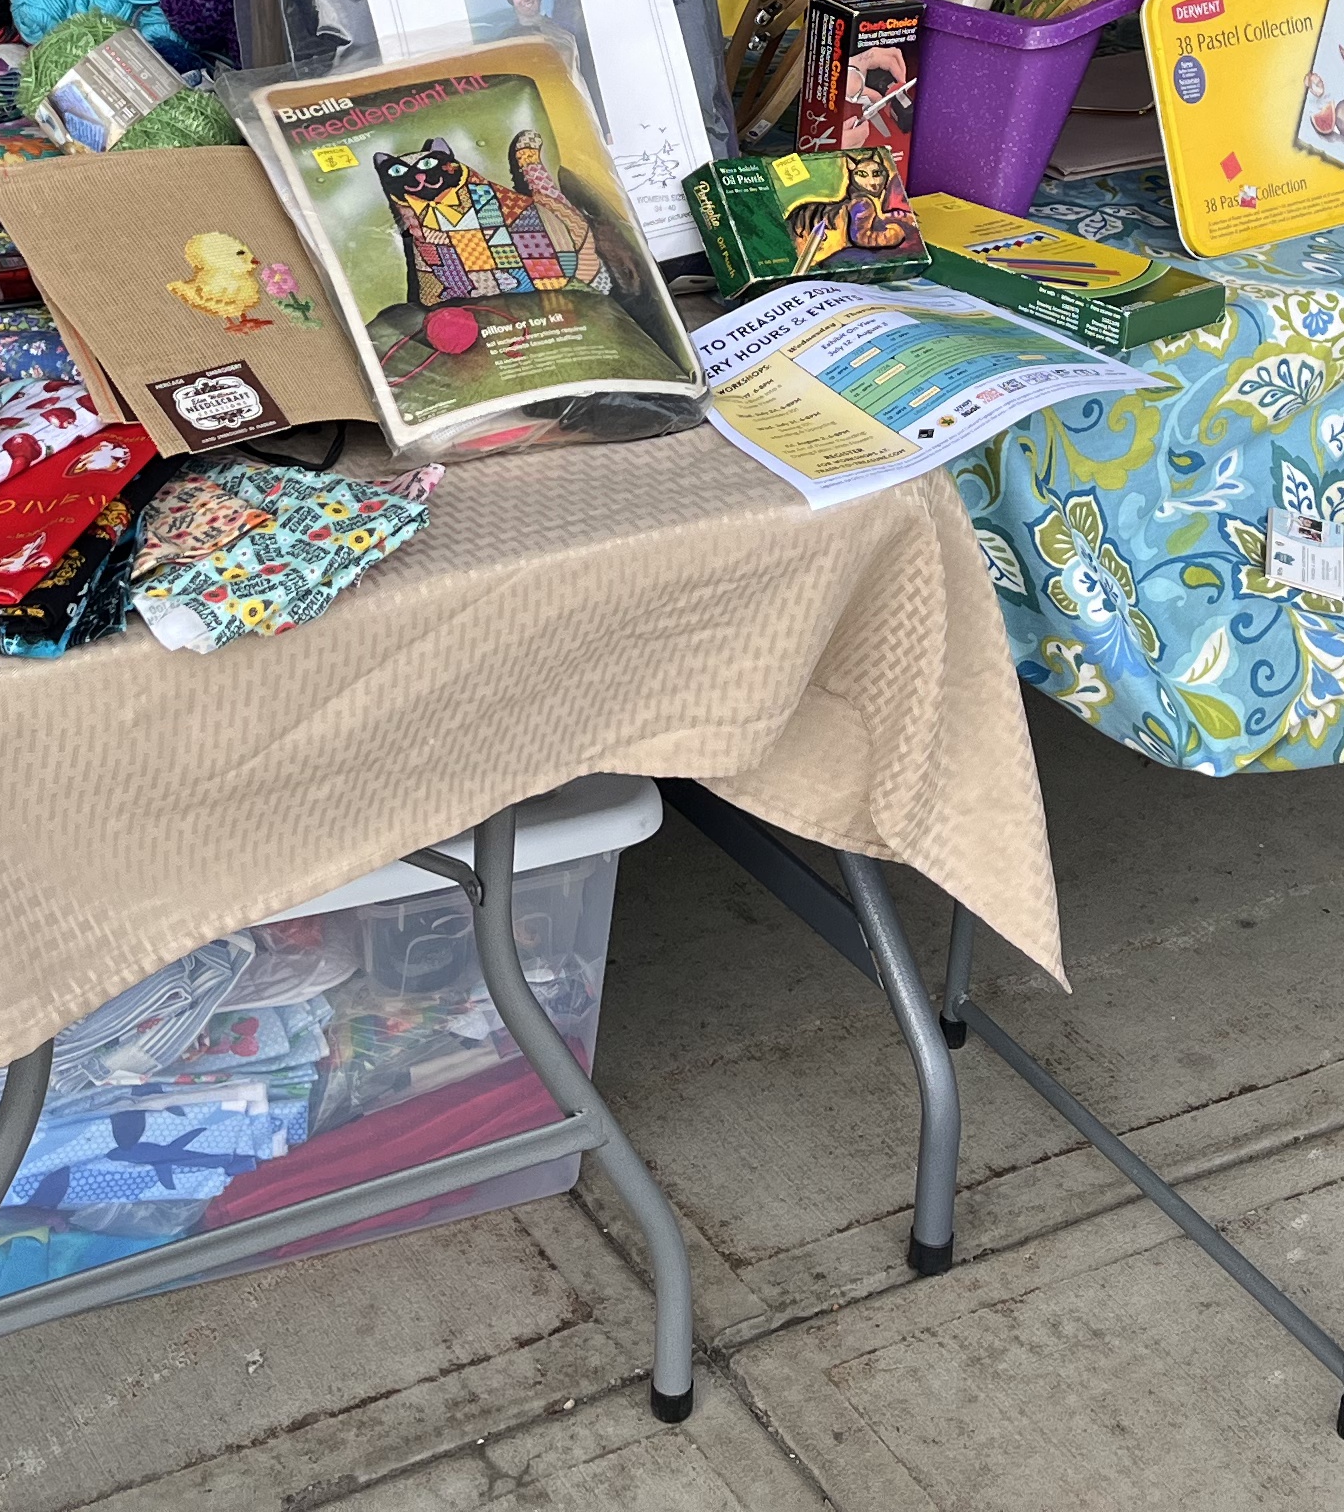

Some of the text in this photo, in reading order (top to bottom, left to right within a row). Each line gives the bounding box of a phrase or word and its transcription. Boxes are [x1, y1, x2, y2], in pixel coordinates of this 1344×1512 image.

[1175, 0, 1222, 20] DERWENT
[1175, 15, 1314, 57] 38 Pastel Collection
[277, 94, 354, 124] Bucilla
[290, 72, 489, 145] needlepoint kit
[317, 148, 346, 156] PRICE
[324, 155, 352, 168] $7
[722, 174, 736, 186] Oil
[693, 180, 722, 228] Portfolio
[1204, 197, 1218, 214] 38
[1255, 178, 1308, 202] Collection
[480, 312, 565, 339] pillow or toy kit
[699, 286, 842, 357] TO TREASURE 2024
[706, 294, 864, 380] ERY HOURS & EVENTS
[787, 322, 838, 353] Wednesday
[820, 328, 846, 350] Exhibit
[846, 324, 859, 334] On
[827, 344, 844, 358] July
[856, 325, 882, 341] August
[716, 364, 772, 396] WORKSHOPS:
[185, 391, 252, 414] NEEDLECRAFT
[823, 448, 865, 460] REGISTER
